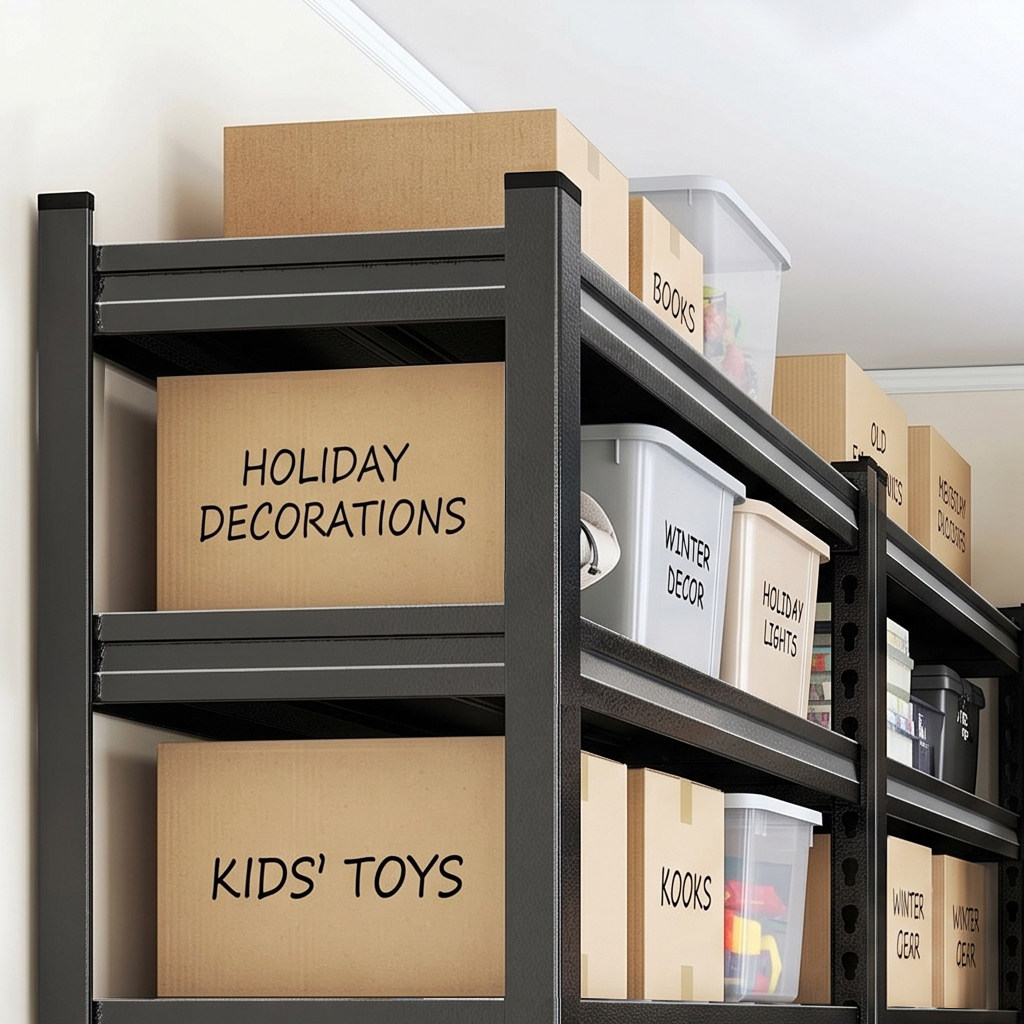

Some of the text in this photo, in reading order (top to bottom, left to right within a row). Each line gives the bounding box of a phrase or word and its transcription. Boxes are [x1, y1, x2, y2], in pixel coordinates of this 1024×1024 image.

[652, 271, 696, 333] BOOKS
[870, 422, 887, 454] OLD
[242, 442, 410, 487] HOLIDAY
[199, 496, 467, 543] DECORATIONS
[664, 520, 711, 572] WINTER
[667, 564, 705, 610] DECOR
[762, 580, 804, 624] HOLIDAY
[763, 625, 798, 658] LIGHTS
[211, 852, 464, 901] KIDS' TOYS
[660, 866, 712, 911] KOOKS
[892, 887, 925, 920] WINTER
